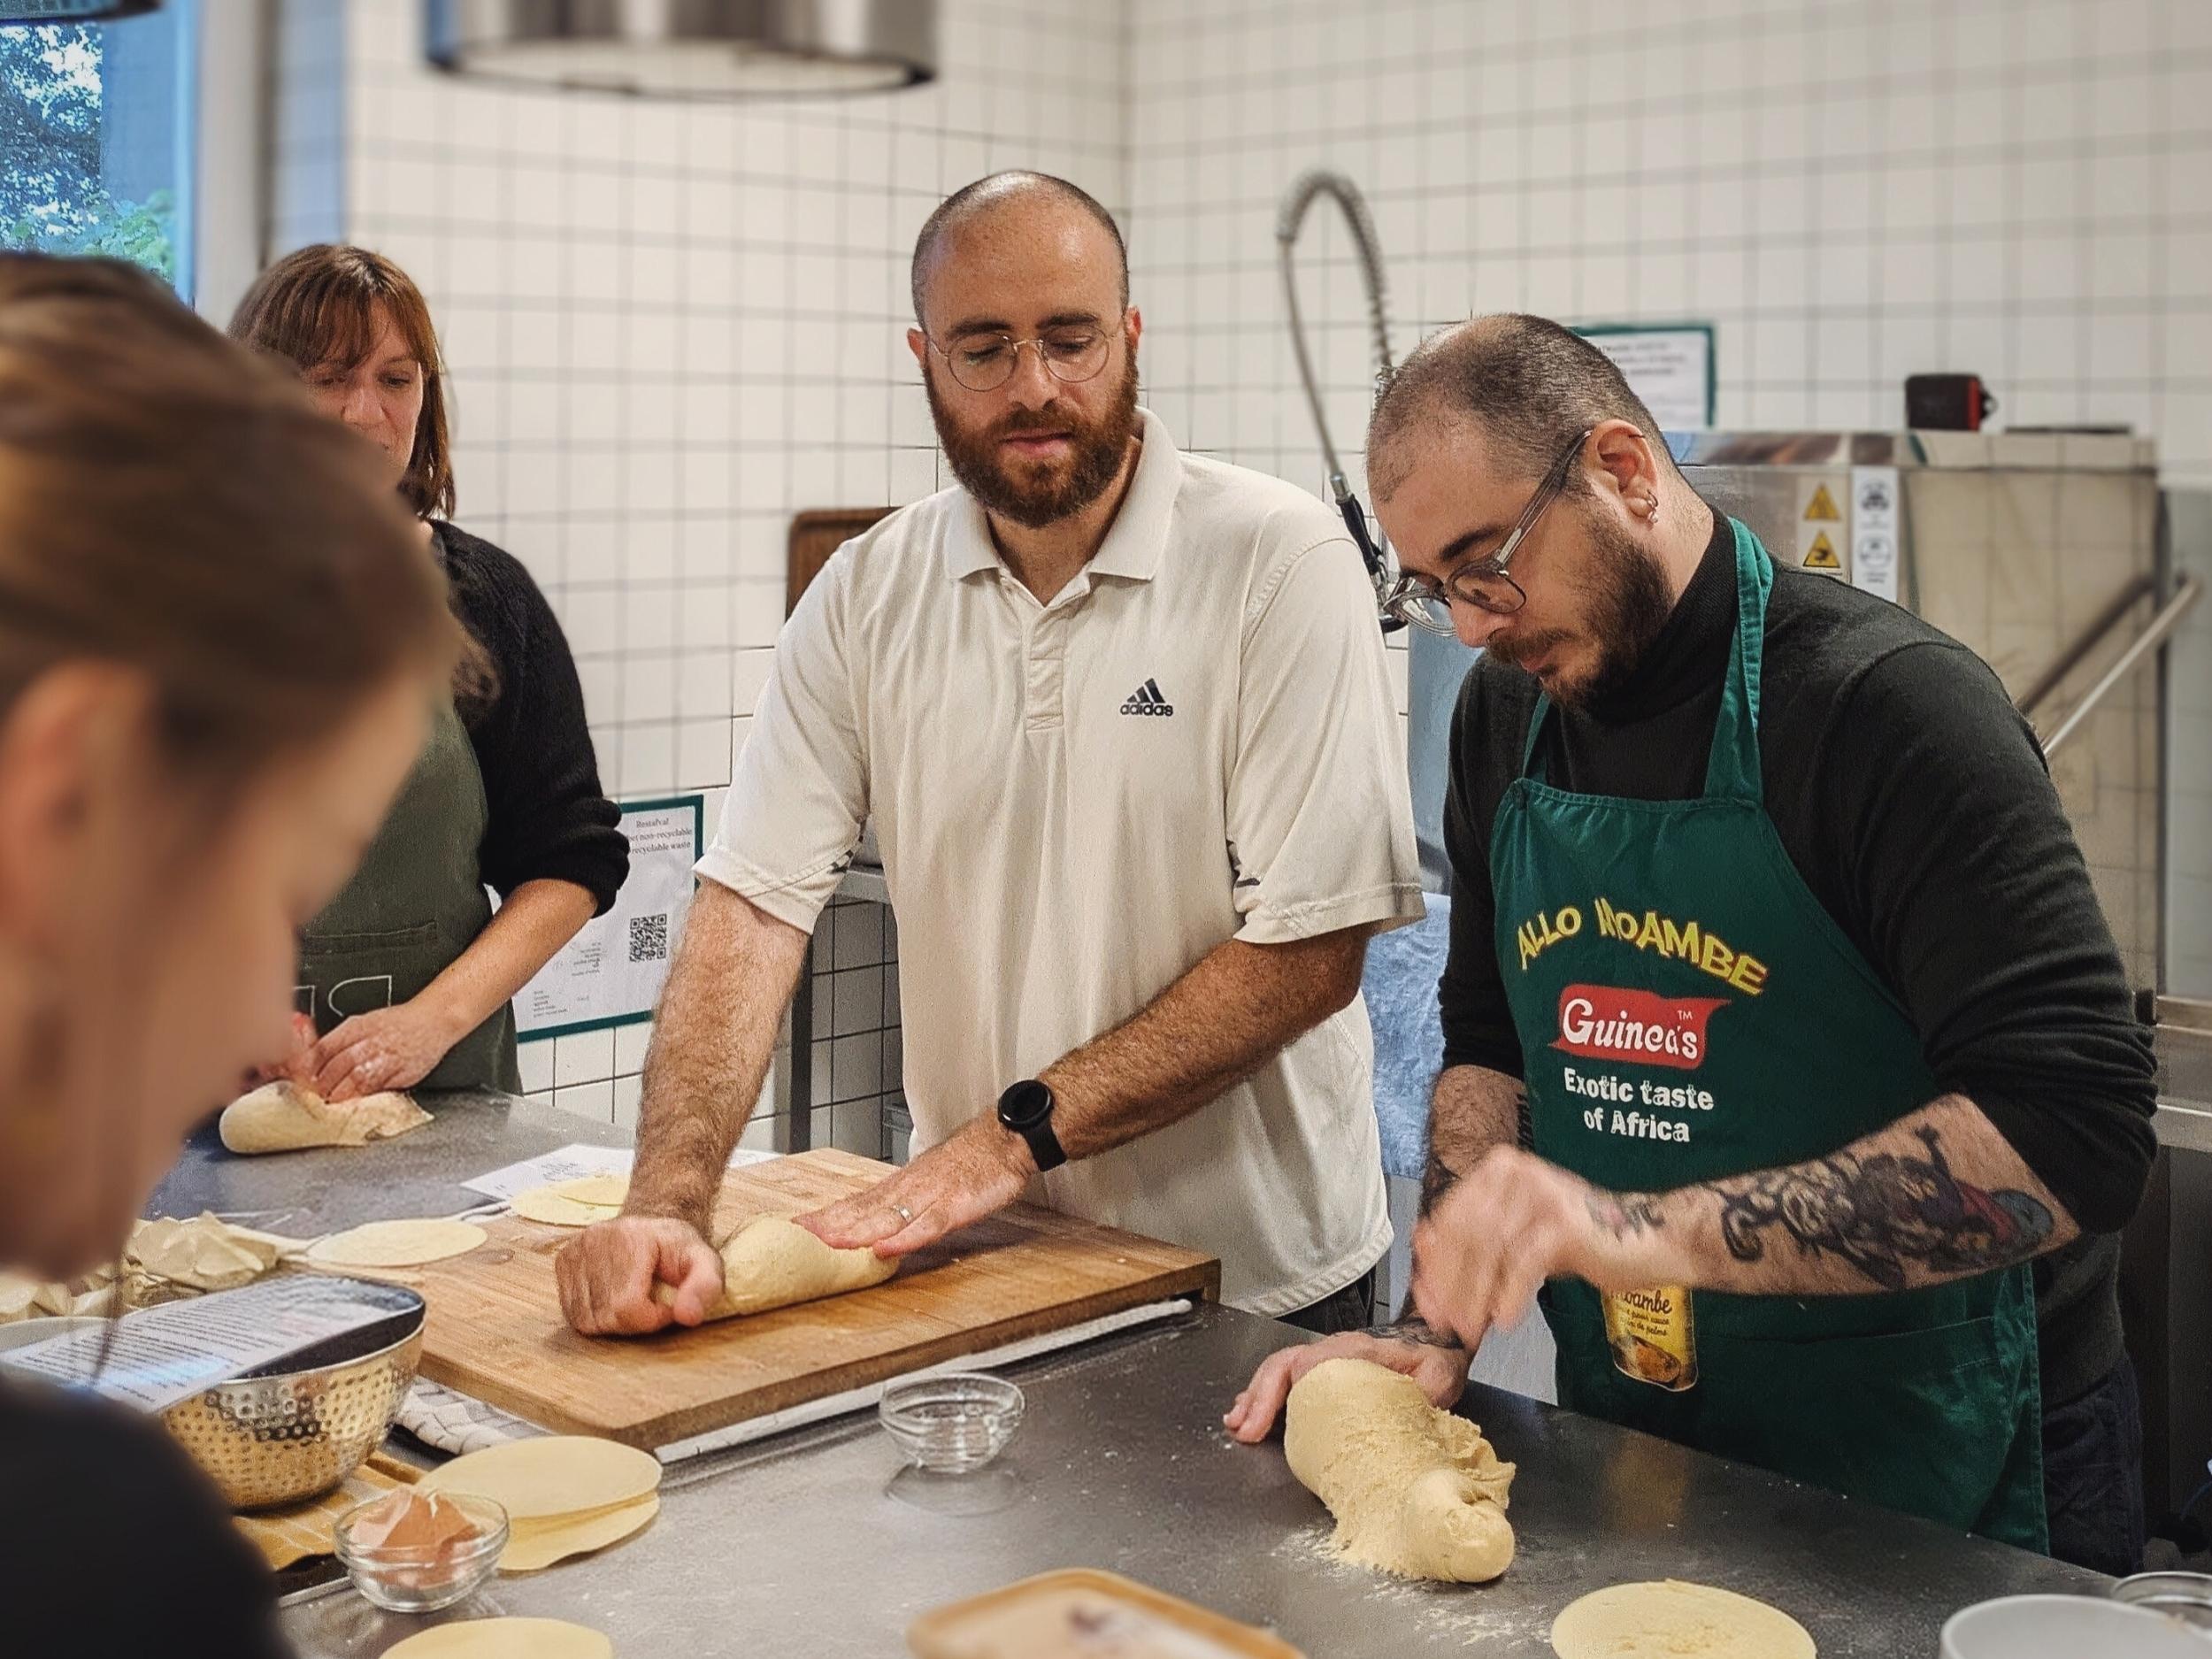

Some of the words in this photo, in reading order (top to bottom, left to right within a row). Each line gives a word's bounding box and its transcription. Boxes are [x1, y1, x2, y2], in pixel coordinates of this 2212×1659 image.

[1120, 703, 1173, 716] adidas
[671, 841, 691, 850] waste
[1517, 907, 1582, 971] ALLO
[1563, 998, 1698, 1060] Guinea's
[1563, 1067, 1633, 1102] Exotic
[1640, 1080, 1714, 1110] taste
[1584, 1107, 1603, 1132] of
[1610, 1110, 1691, 1142] Africa
[1624, 1289, 1672, 1314] oambe
